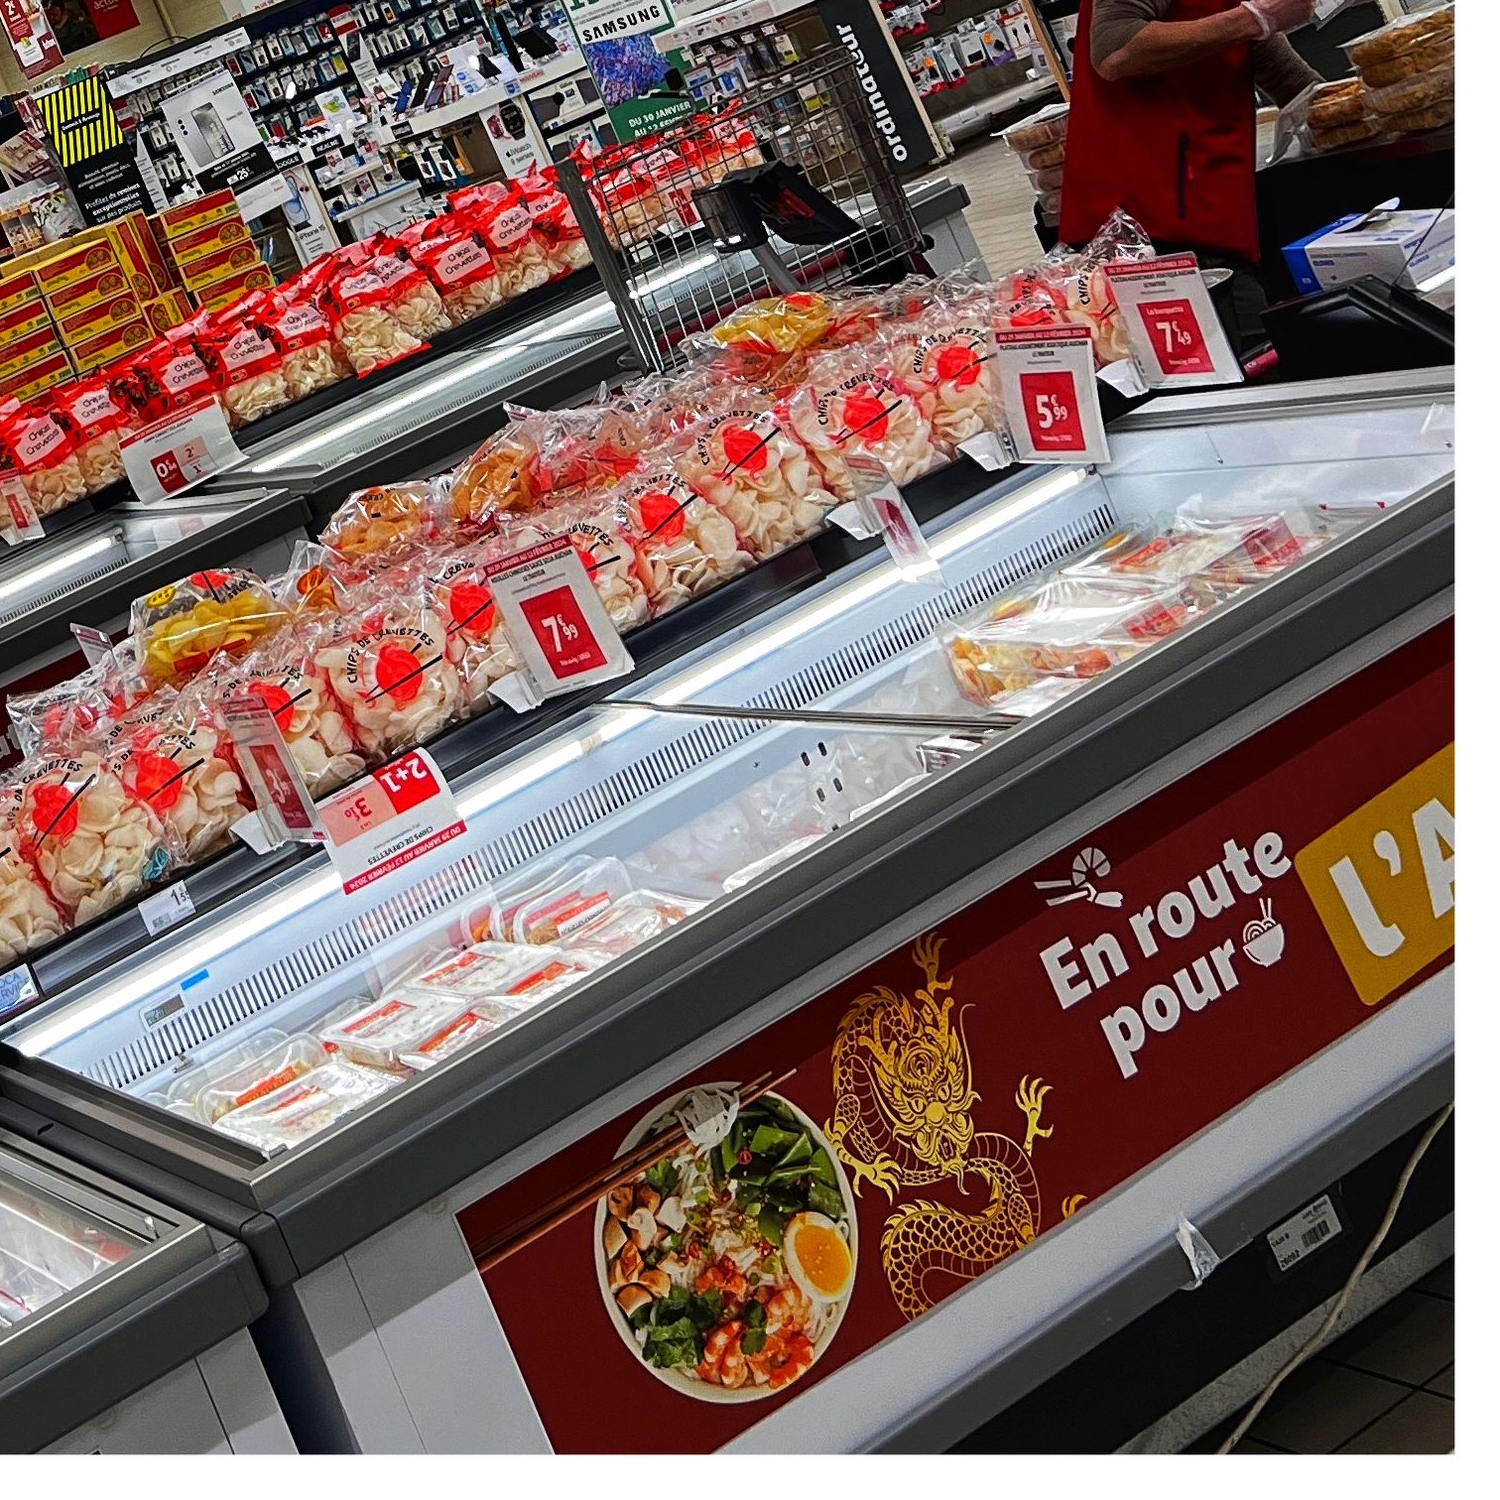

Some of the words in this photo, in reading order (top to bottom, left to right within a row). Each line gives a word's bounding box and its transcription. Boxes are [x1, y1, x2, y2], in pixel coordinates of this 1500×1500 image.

[582, 6, 660, 42] SAMSUNG
[628, 117, 642, 128] DU
[643, 113, 655, 124] 30
[653, 101, 692, 119] JANVIER
[836, 23, 909, 163] ordinateur
[348, 648, 361, 684] CHIPS
[358, 635, 371, 648] DE
[380, 757, 427, 793] 2+1
[1039, 934, 1127, 1011] En
[1127, 827, 1293, 957] route
[1099, 950, 1242, 1079] pour
